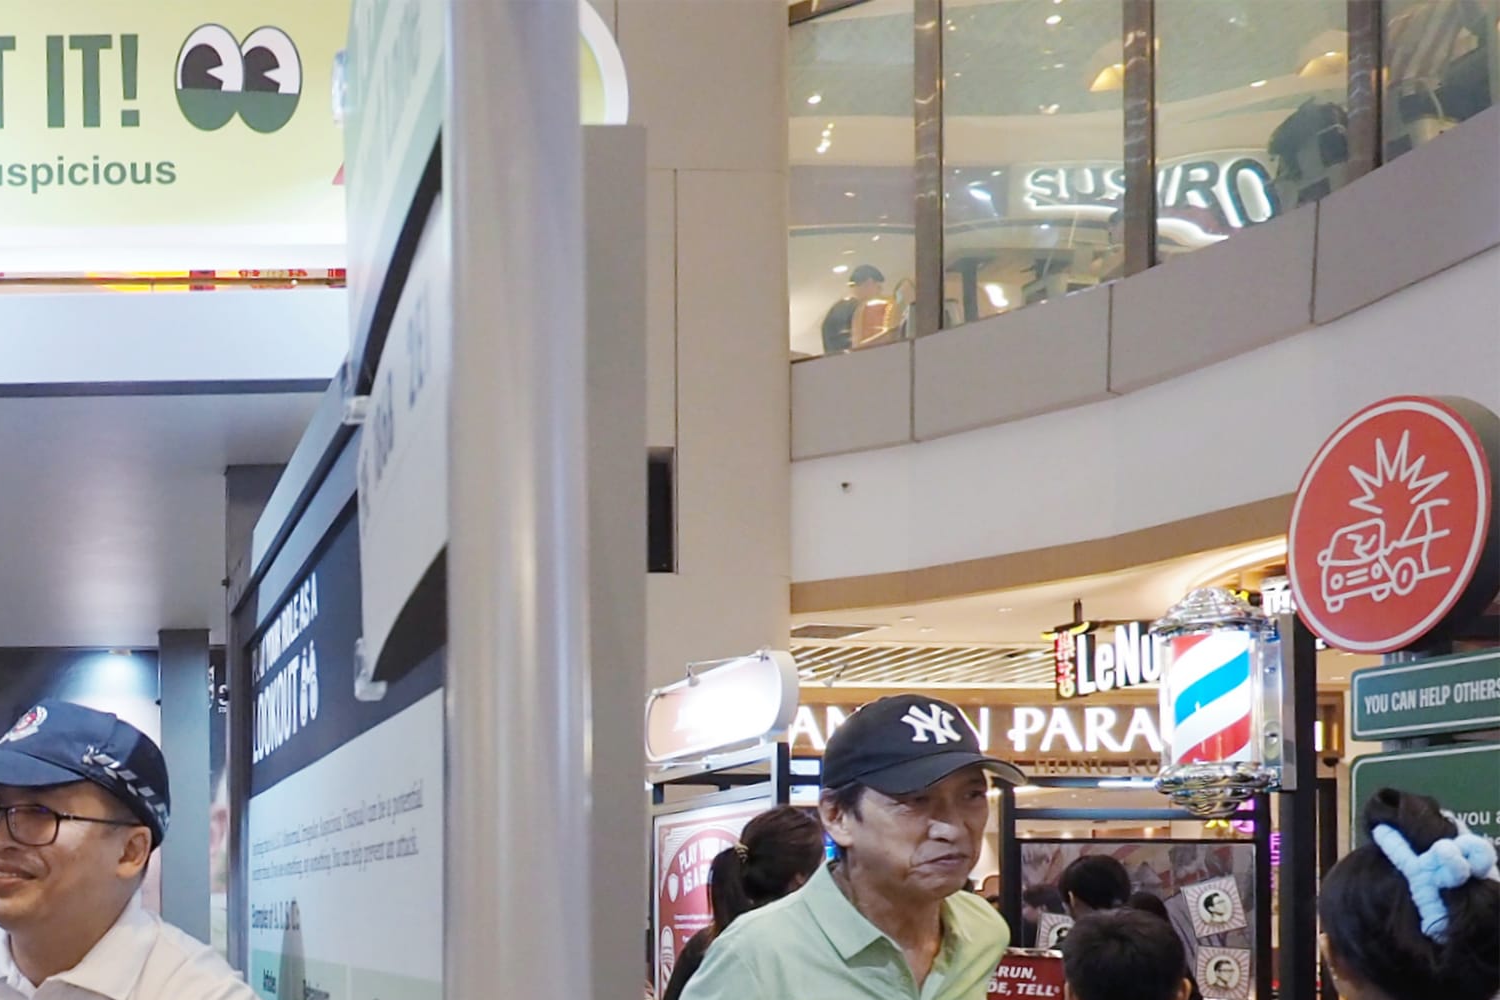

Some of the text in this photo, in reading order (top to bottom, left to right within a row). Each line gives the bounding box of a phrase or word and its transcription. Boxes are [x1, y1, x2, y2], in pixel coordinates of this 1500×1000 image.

[46, 34, 140, 128] IT!
[1024, 158, 1282, 230] SUSIRO
[311, 571, 318, 620] A
[252, 655, 300, 765] LOOKOUT
[1364, 693, 1388, 715] YOU
[1391, 689, 1416, 712] CAN
[1419, 684, 1451, 709] HELP
[1008, 706, 1164, 753] PARA
[1034, 757, 1164, 775] HONG KO
[678, 840, 698, 873] PLAY
[987, 980, 1012, 996] DE,
[997, 965, 1037, 981] RUN,
